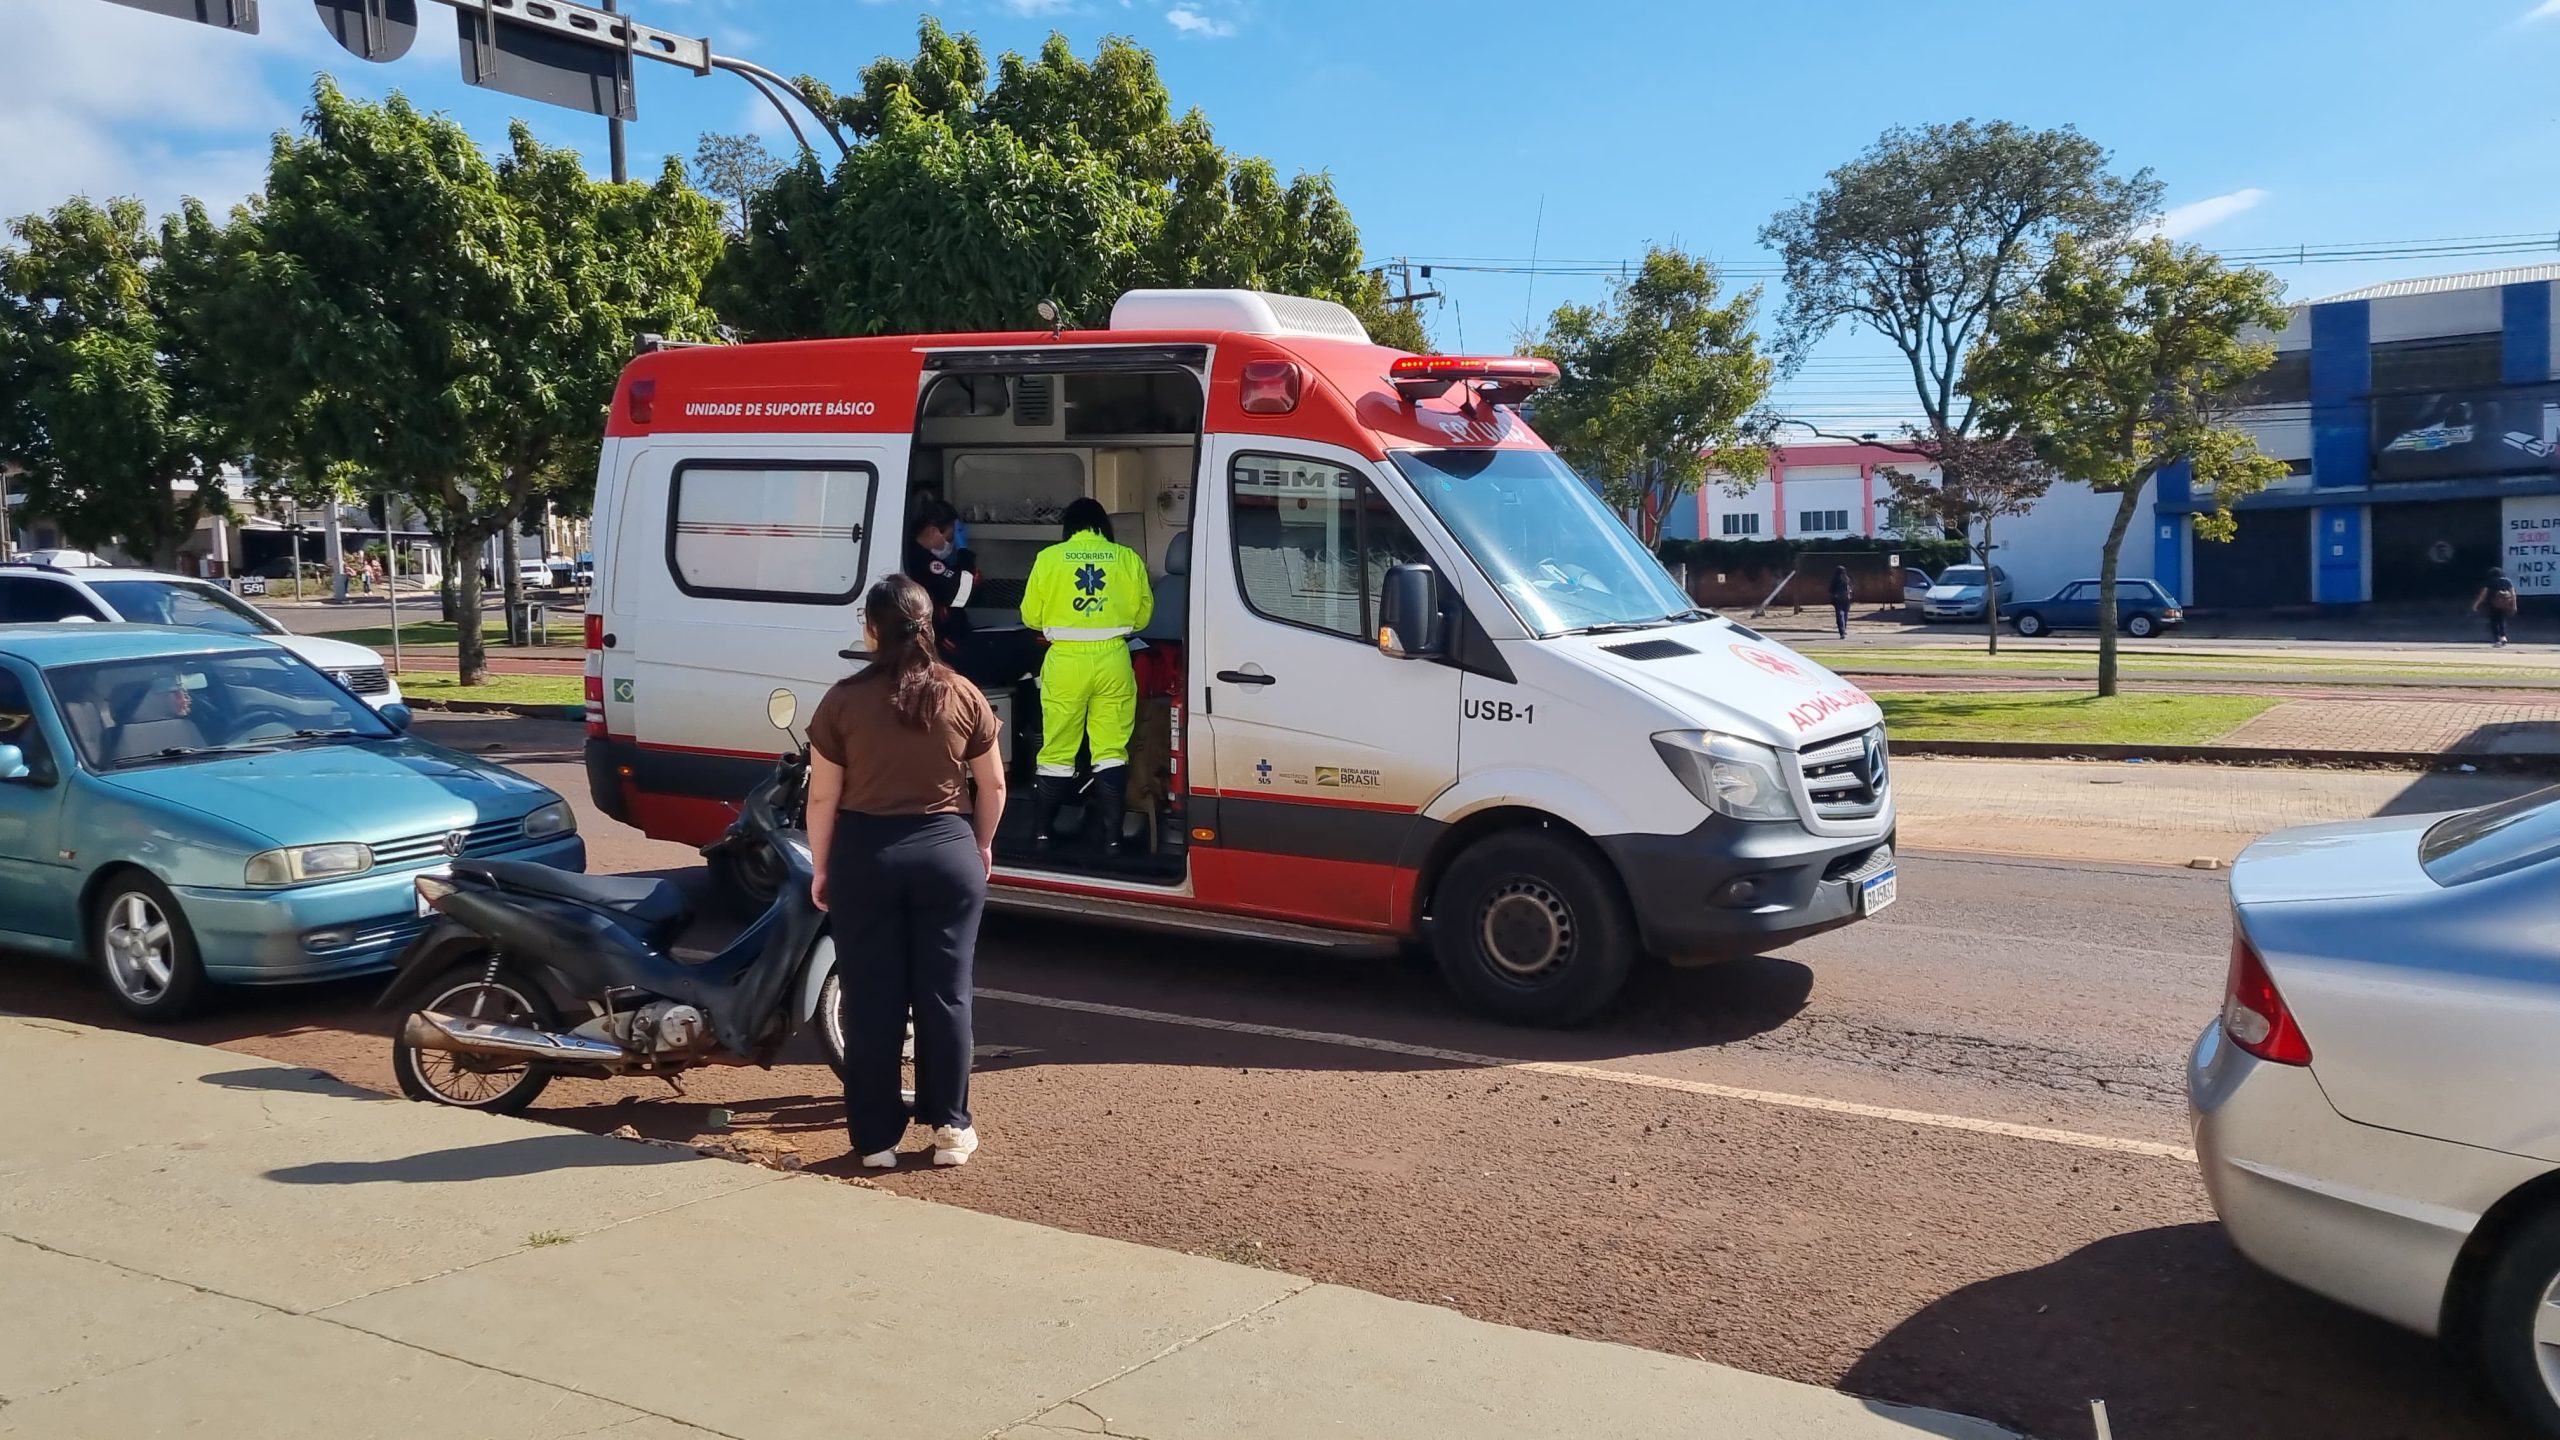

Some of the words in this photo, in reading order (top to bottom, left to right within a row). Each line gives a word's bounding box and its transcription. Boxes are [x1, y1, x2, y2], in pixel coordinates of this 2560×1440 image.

[685, 403, 742, 416] UNIDADE
[745, 403, 762, 416] DE
[765, 402, 822, 416] SUPORTE
[826, 399, 875, 416] BÁSICO
[1065, 552, 1114, 560] SOCORRISTA
[2518, 561, 2556, 572] INOX
[2519, 575, 2551, 587] MIG
[1464, 698, 1534, 725] USB-1
[1258, 776, 1272, 785] SUS
[1340, 773, 1381, 786] BRASIL
